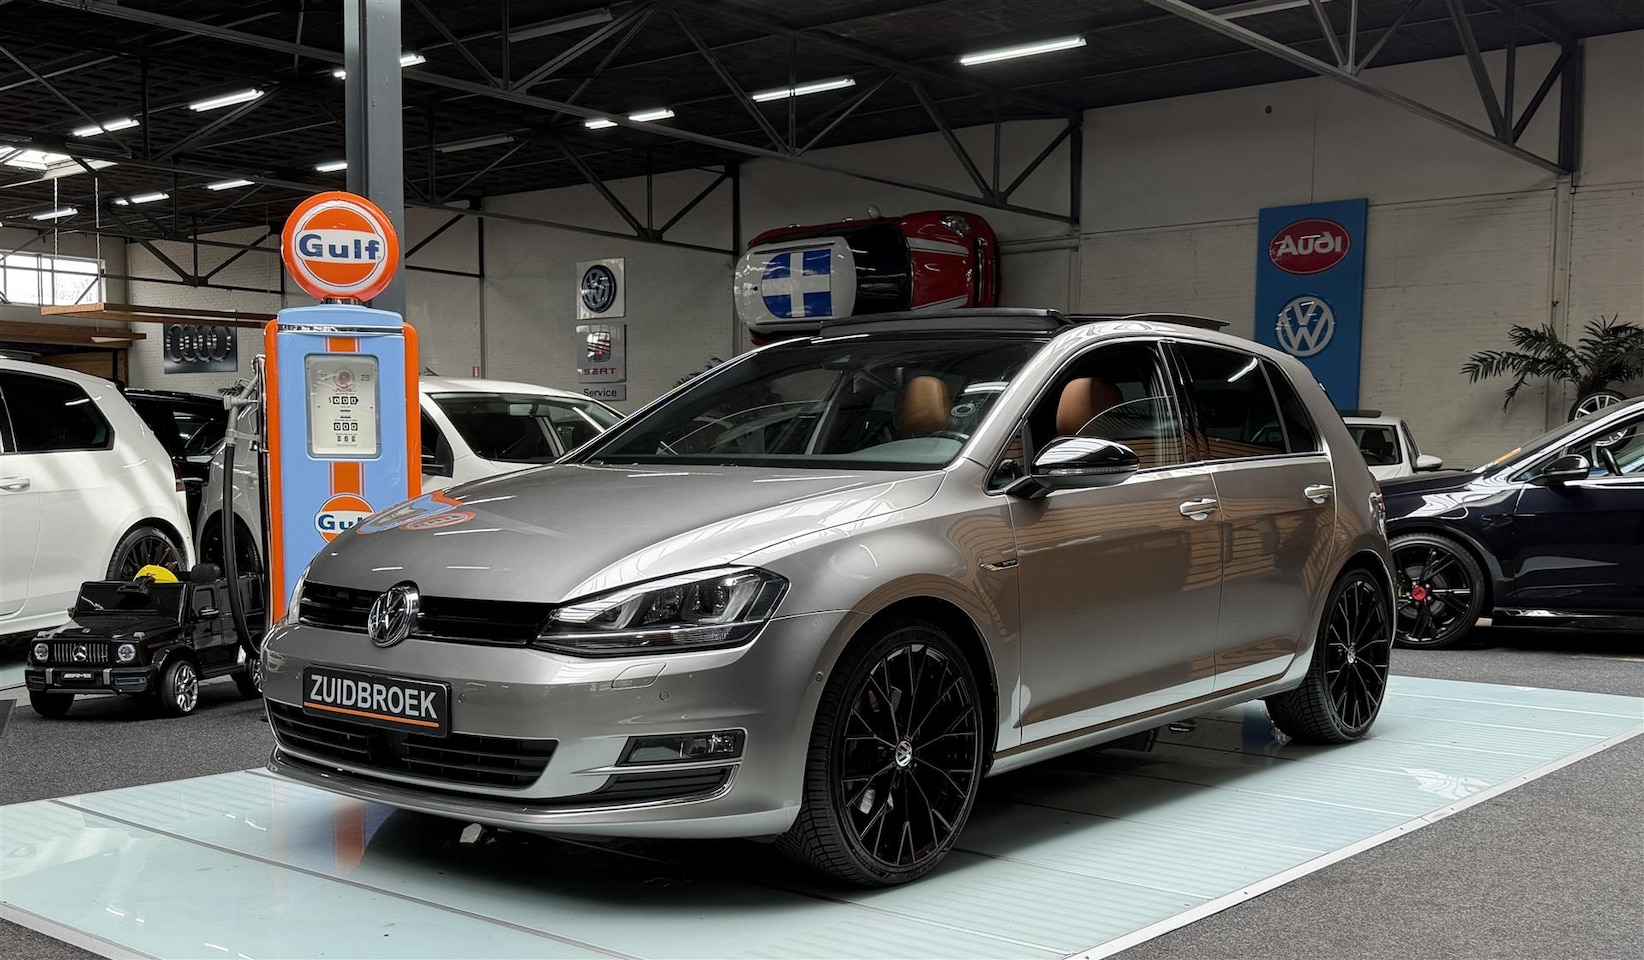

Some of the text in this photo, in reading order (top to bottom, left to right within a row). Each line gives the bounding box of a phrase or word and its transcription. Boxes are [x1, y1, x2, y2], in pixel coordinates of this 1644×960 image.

[299, 234, 380, 260] Gulf
[583, 367, 617, 375] SEAT
[583, 388, 617, 397] Service
[310, 674, 438, 719] ZUIDBROEK
